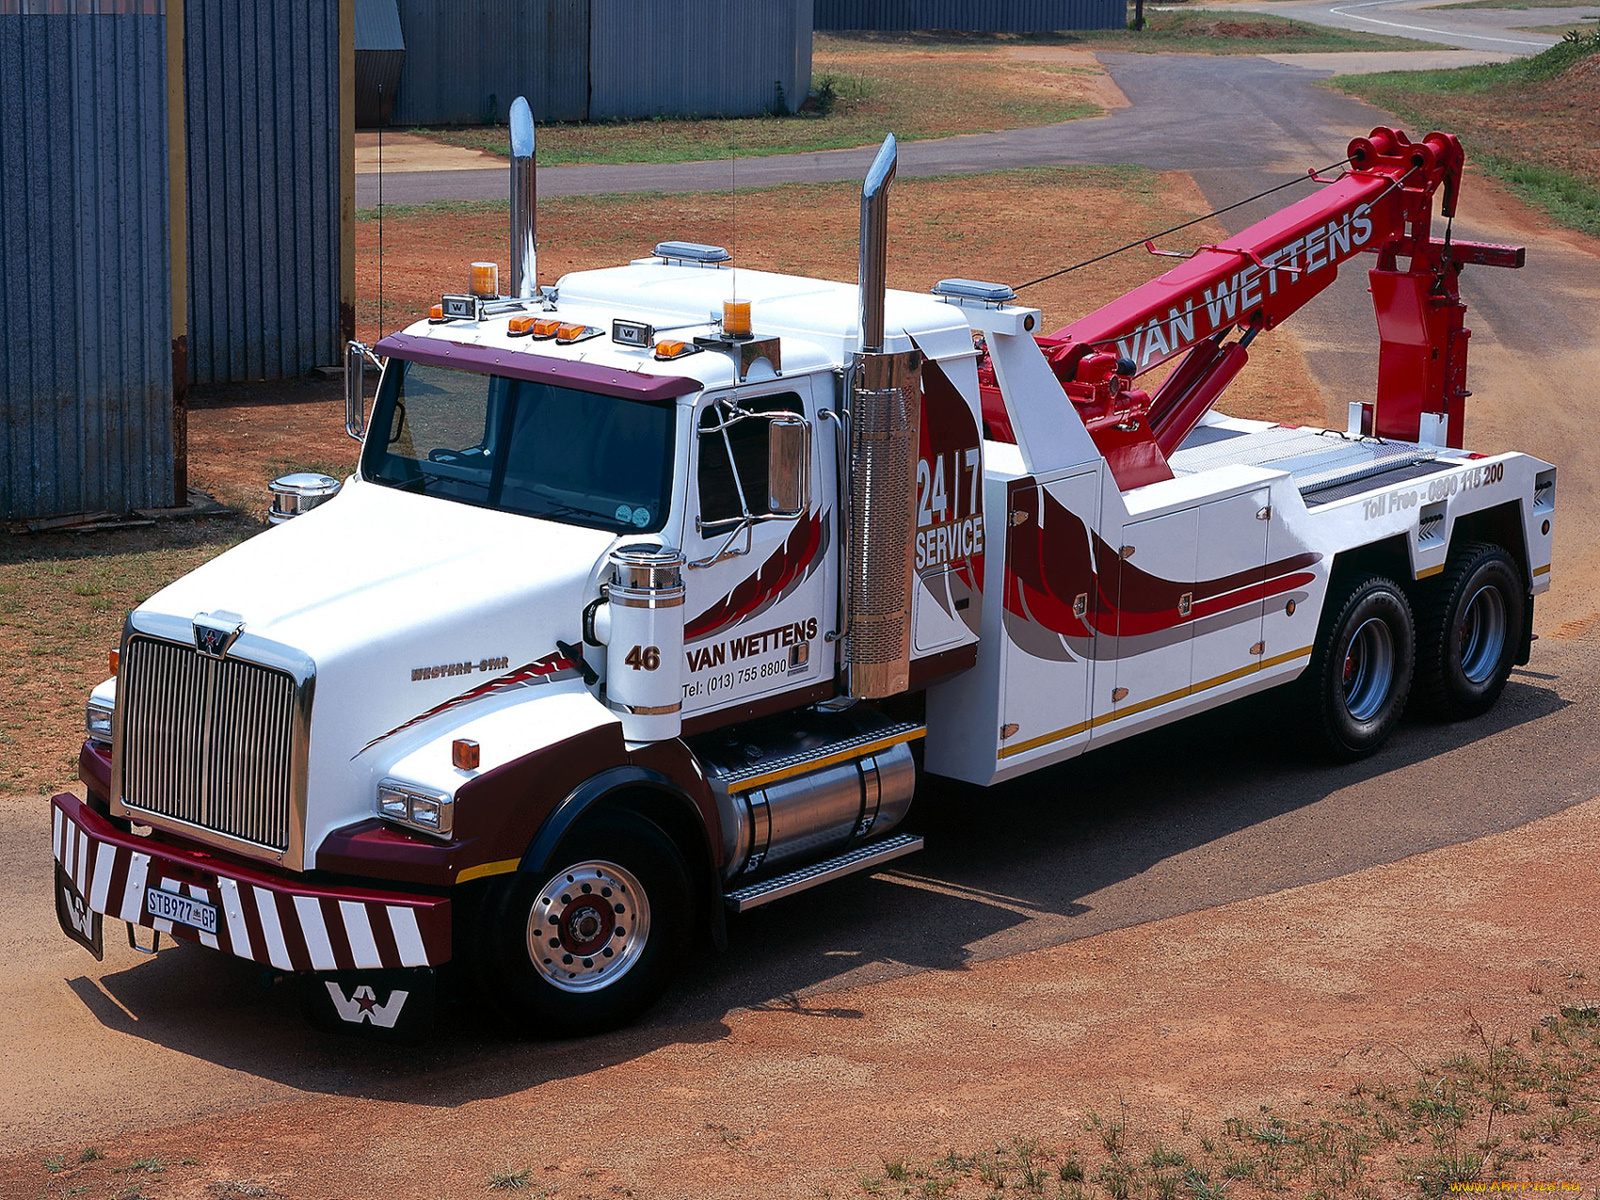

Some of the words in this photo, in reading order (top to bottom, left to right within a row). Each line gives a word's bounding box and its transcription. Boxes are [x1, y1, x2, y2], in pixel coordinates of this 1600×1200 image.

[1116, 298, 1197, 368] VAN
[1203, 203, 1374, 330] WETTENS
[1363, 496, 1385, 521] Toll
[1428, 475, 1459, 503] 0800
[1460, 467, 1481, 492] 115
[1483, 462, 1504, 485] 200
[915, 513, 984, 570] SERVICE
[624, 644, 661, 671] 46
[686, 641, 726, 673] VAN
[730, 616, 819, 662] WETTENS
[682, 680, 704, 699] Tel:
[706, 671, 735, 696] (013)
[738, 665, 758, 684] 755
[760, 658, 787, 678] 8800
[149, 891, 192, 922] STB977
[202, 907, 216, 929] GP
